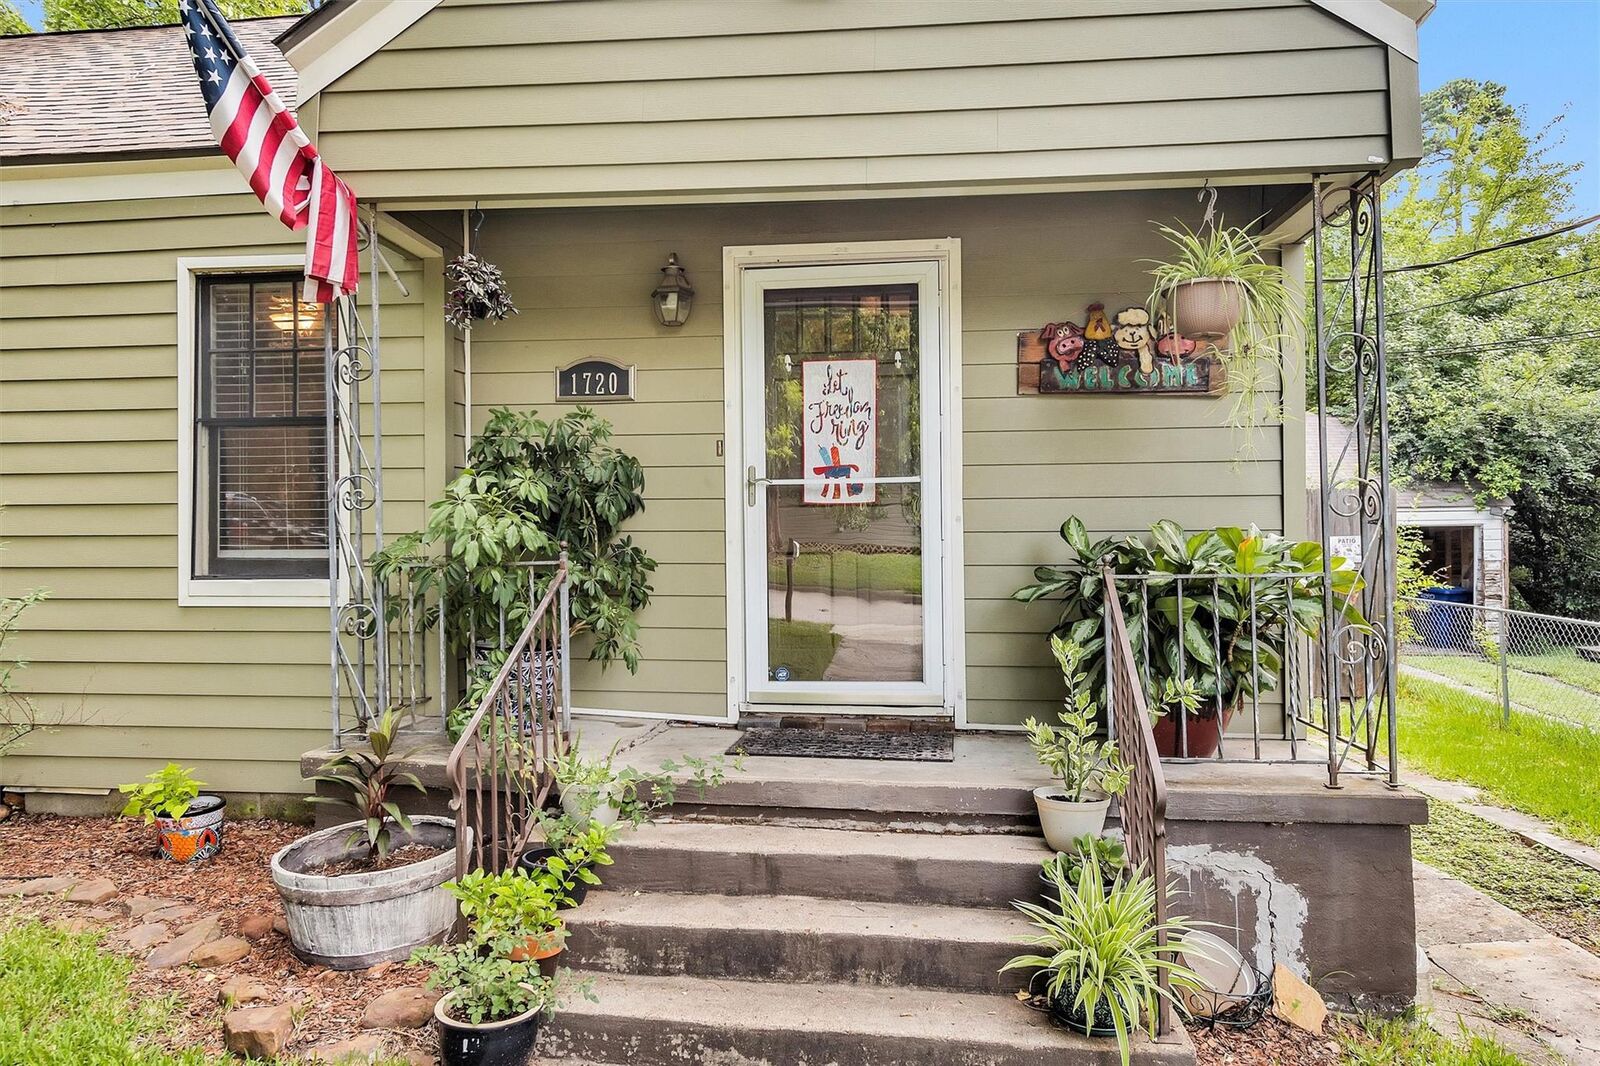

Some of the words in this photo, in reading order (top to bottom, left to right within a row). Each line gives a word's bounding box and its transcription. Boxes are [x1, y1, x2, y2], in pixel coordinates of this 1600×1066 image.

[571, 372, 617, 395] 1720
[1053, 364, 1198, 389] WELCOME
[831, 419, 869, 450] ring
